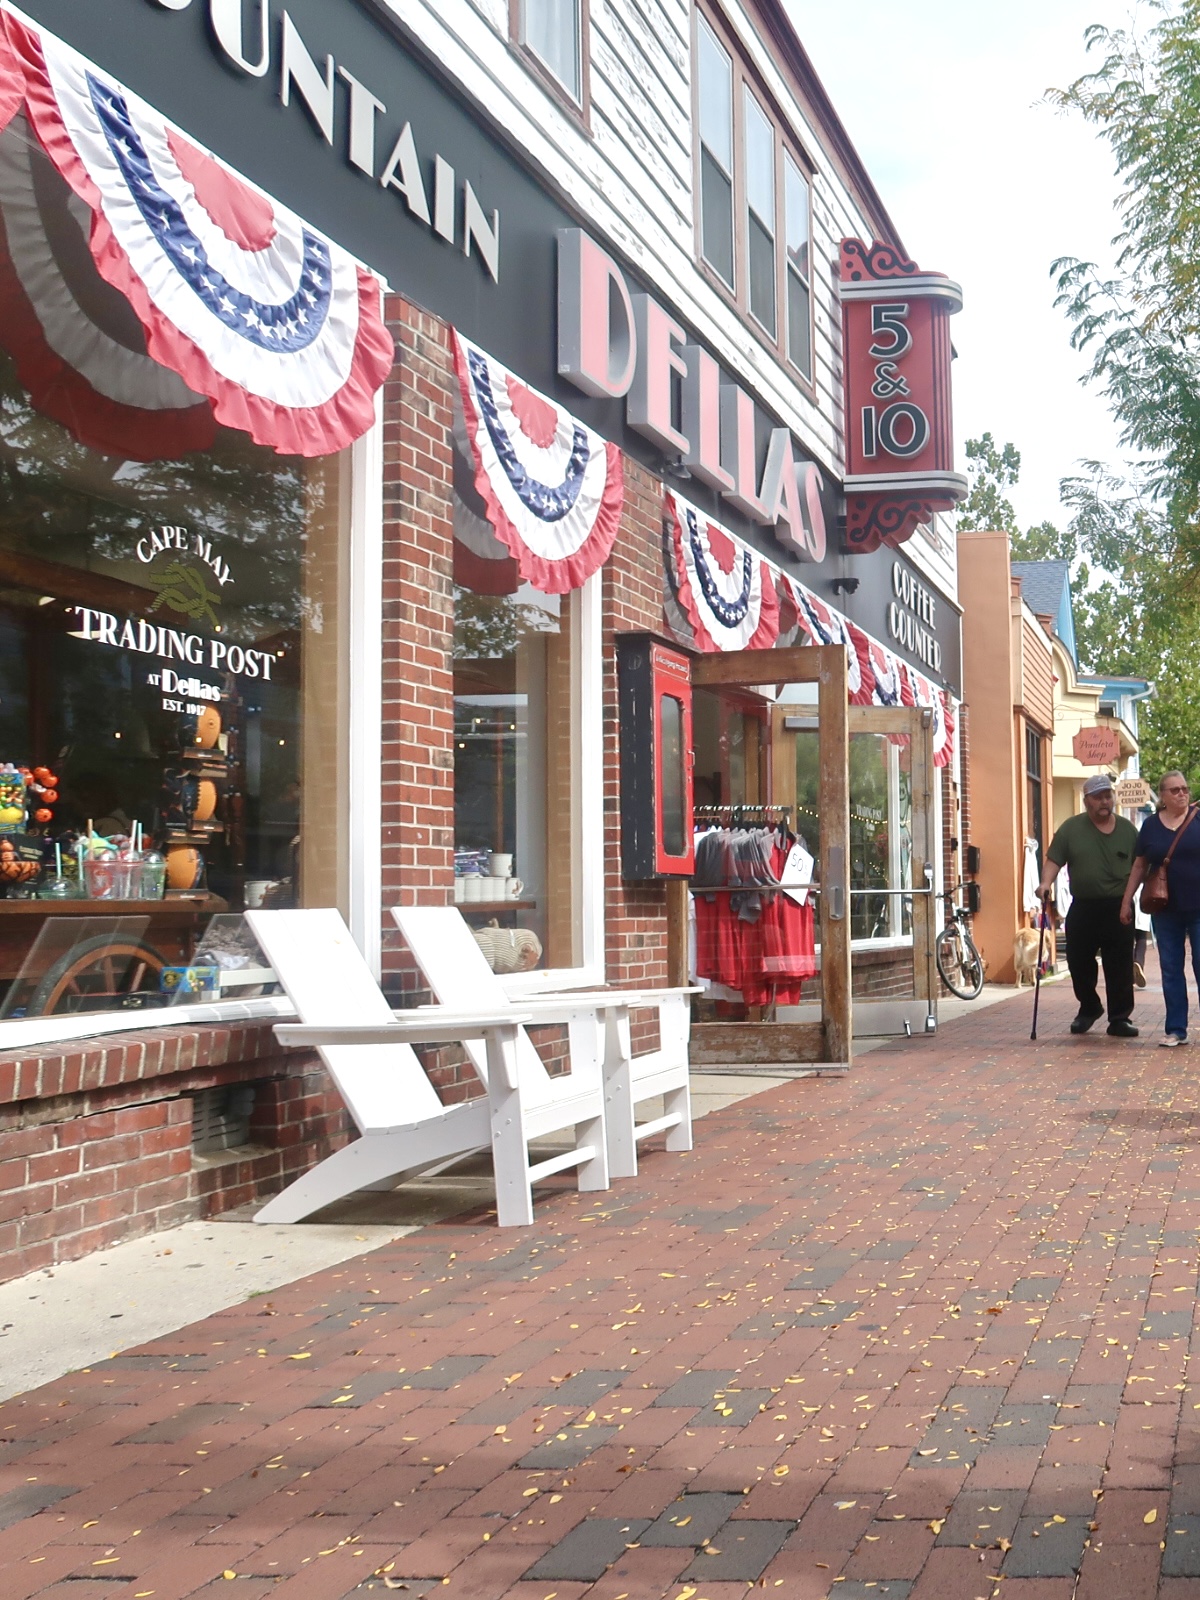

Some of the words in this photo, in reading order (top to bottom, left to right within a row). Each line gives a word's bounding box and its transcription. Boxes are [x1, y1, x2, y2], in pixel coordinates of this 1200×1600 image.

[155, 0, 499, 284] UNTAIN
[868, 303, 912, 360] 5
[558, 228, 826, 563] DELLAS
[871, 361, 911, 399] &
[861, 401, 931, 460] 10
[136, 525, 188, 564] CAPE
[195, 535, 235, 587] MAY
[892, 560, 937, 631] COFFEE
[75, 606, 204, 665] TRADING
[209, 639, 277, 681] POST
[889, 601, 942, 674] COUNTER
[146, 673, 161, 686] AT
[162, 668, 221, 702] Dellas
[162, 698, 185, 713] EST.
[186, 703, 207, 716] 1917
[1086, 749, 1107, 761] Shop
[1117, 789, 1147, 797] PIZZERIA
